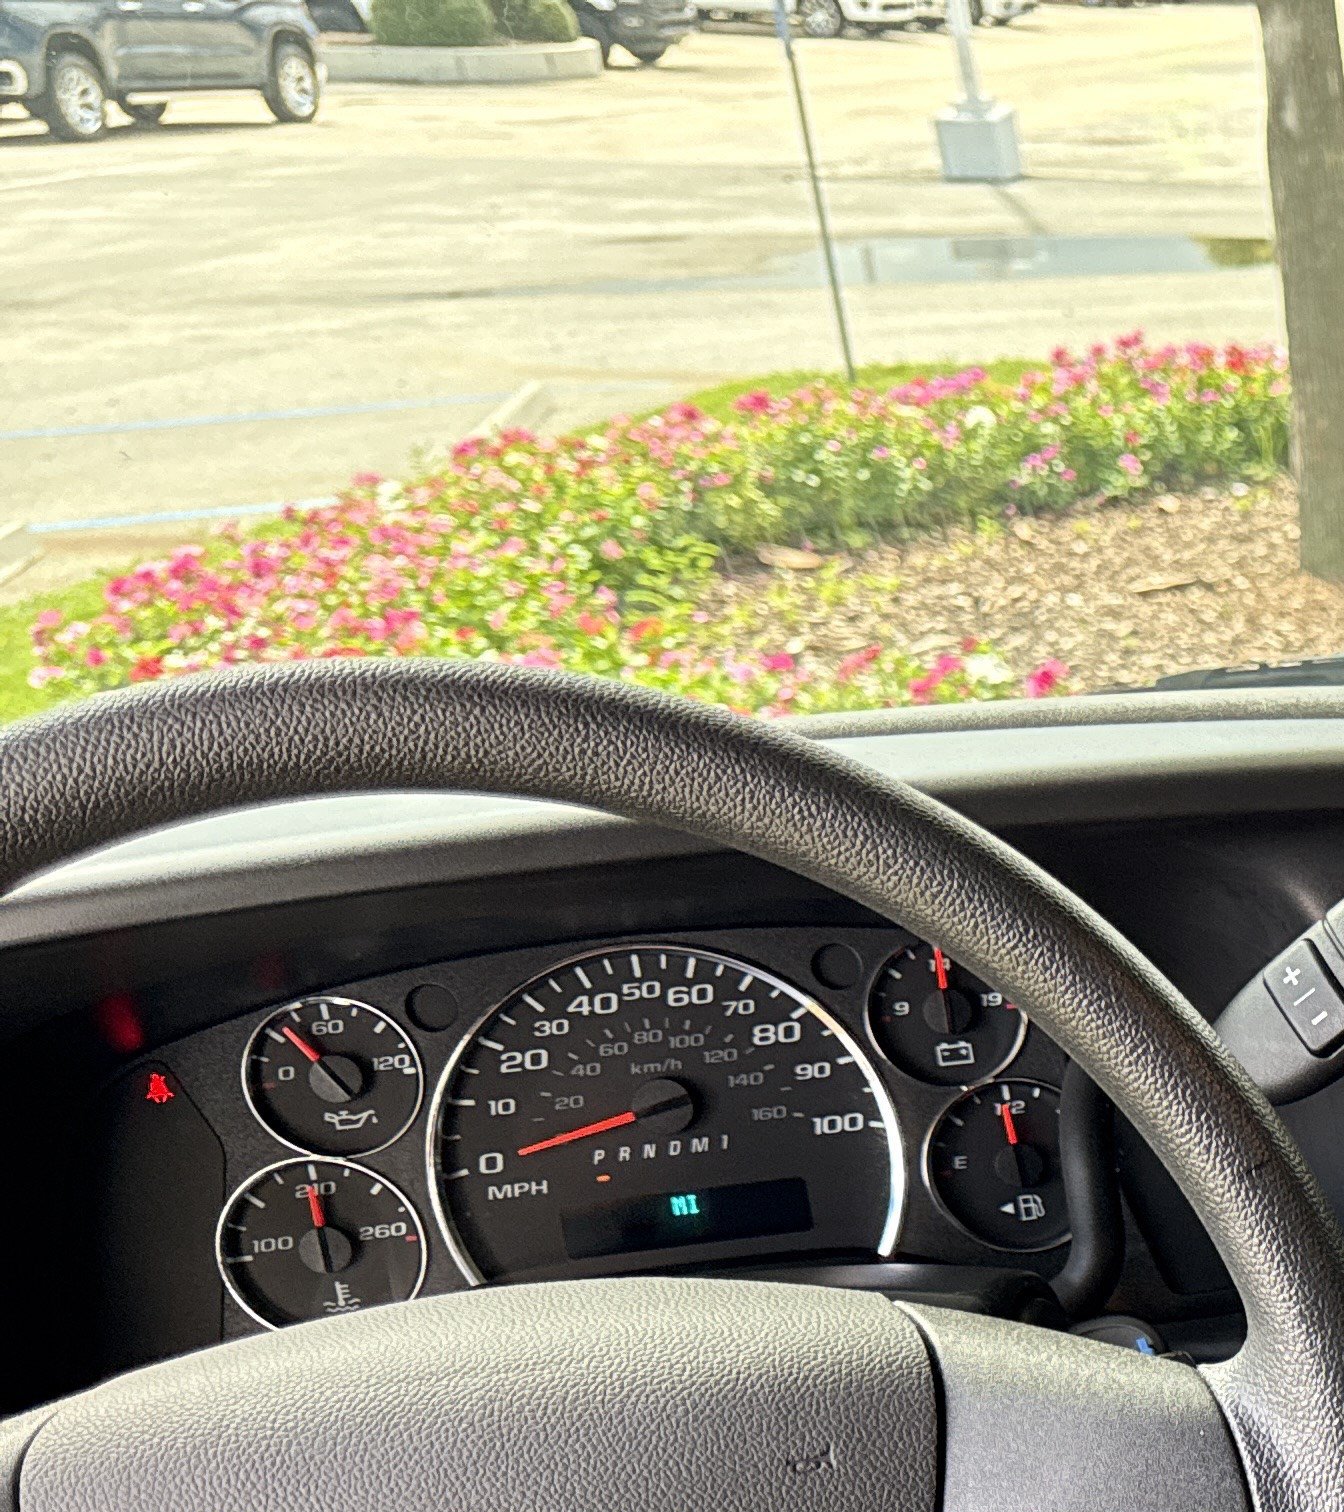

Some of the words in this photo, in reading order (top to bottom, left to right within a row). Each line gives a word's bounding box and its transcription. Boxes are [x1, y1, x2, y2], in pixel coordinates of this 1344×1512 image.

[621, 981, 661, 1000] 50
[667, 983, 713, 1007] 60
[566, 992, 618, 1016] 40
[722, 999, 755, 1017] 70
[982, 992, 1002, 1007] 19
[892, 1001, 909, 1016] 9
[311, 1019, 344, 1036] 60
[533, 1019, 569, 1037] 30
[752, 1021, 801, 1046] 80
[633, 1029, 662, 1044] 80
[668, 1033, 705, 1048] 100
[599, 1041, 628, 1057] 60
[703, 1048, 738, 1064] 120
[373, 1054, 410, 1071] 120
[500, 1049, 548, 1073] 20
[570, 1062, 601, 1077] 40
[630, 1058, 682, 1075] km/h
[277, 1066, 295, 1081] 0
[794, 1061, 831, 1080] 90
[728, 1072, 764, 1087] 140
[488, 1098, 516, 1116] 10
[554, 1095, 584, 1110] 20
[752, 1105, 787, 1121] 160
[812, 1112, 864, 1135] 100
[593, 1149, 605, 1165] P
[618, 1146, 631, 1161] R
[643, 1143, 656, 1159] N
[669, 1140, 681, 1156] D
[691, 1137, 709, 1153] M
[478, 1152, 504, 1174] 0
[954, 1155, 968, 1170] E
[487, 1179, 549, 1200] MPH
[359, 1222, 407, 1241] 260
[251, 1236, 294, 1253] 100
